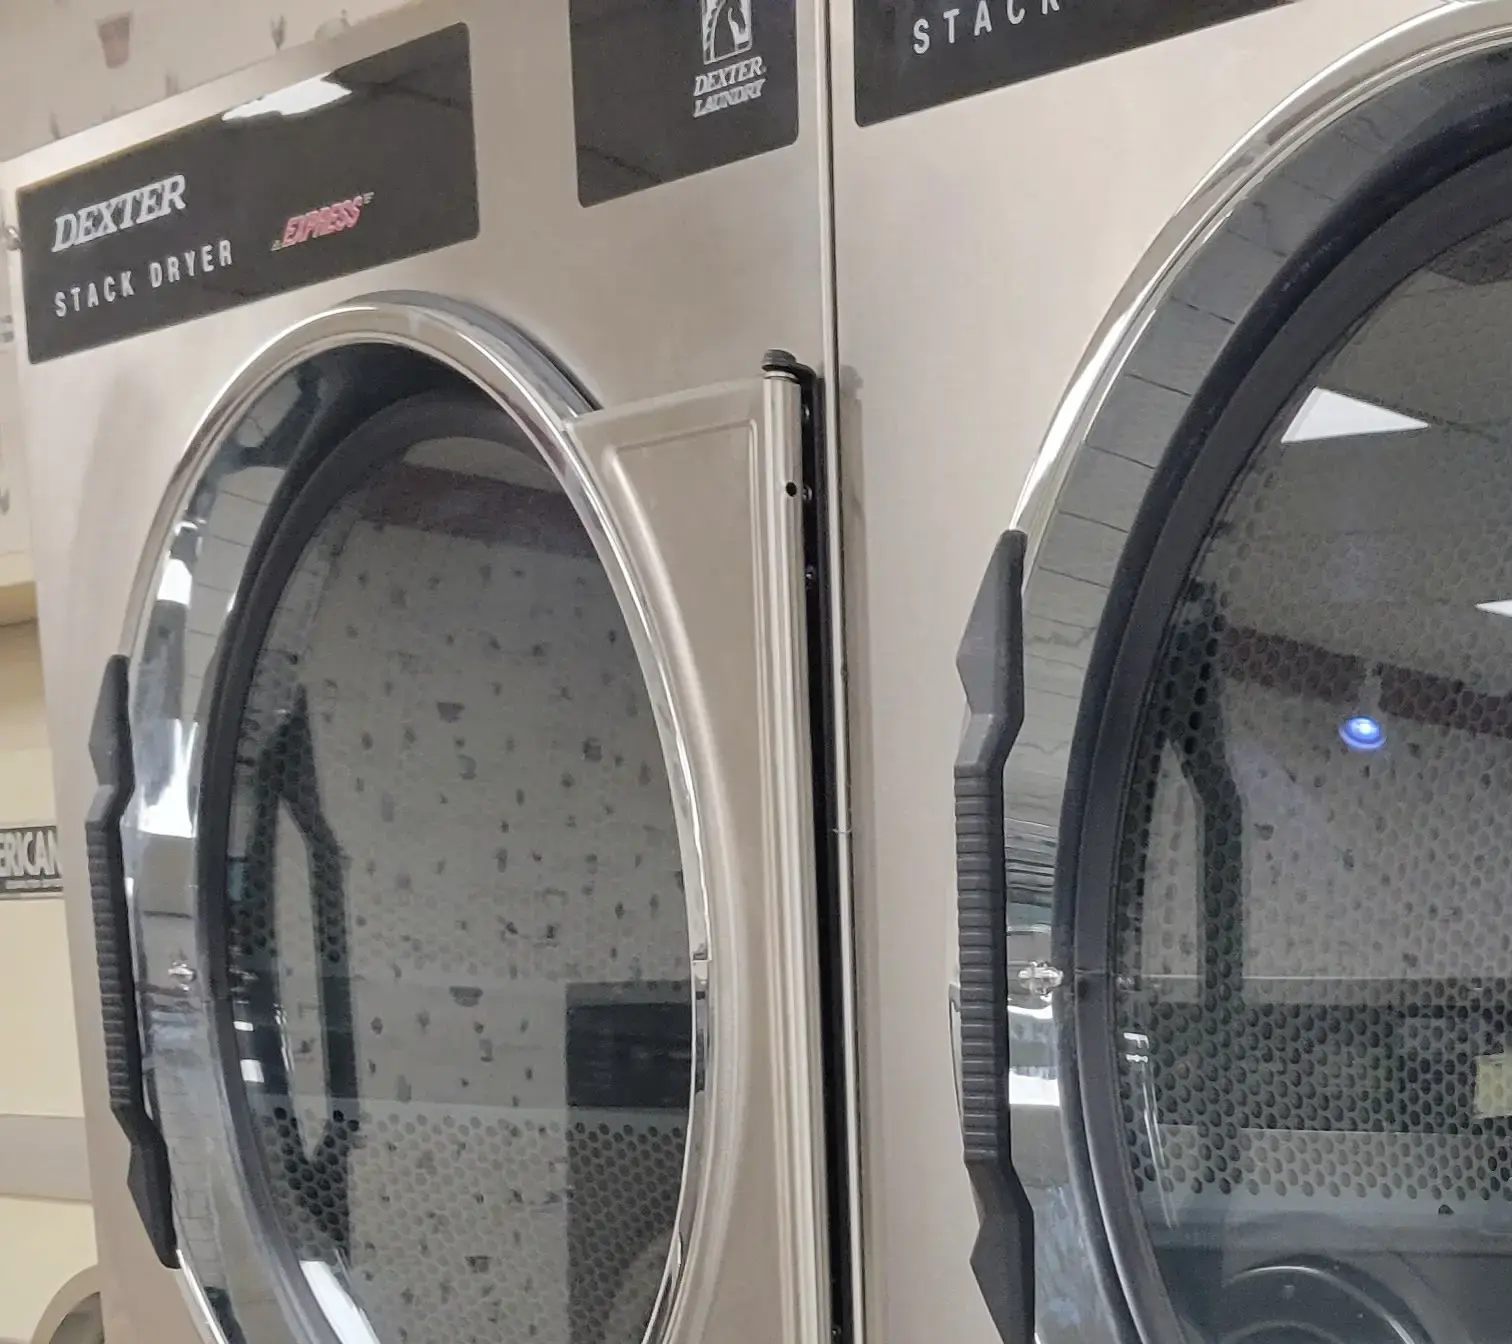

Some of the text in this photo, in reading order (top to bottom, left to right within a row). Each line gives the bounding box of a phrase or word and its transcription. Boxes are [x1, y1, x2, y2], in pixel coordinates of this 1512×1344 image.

[693, 56, 762, 97] DEXTER
[52, 174, 186, 253] DEXTER
[54, 239, 232, 318] STACK DRYER
